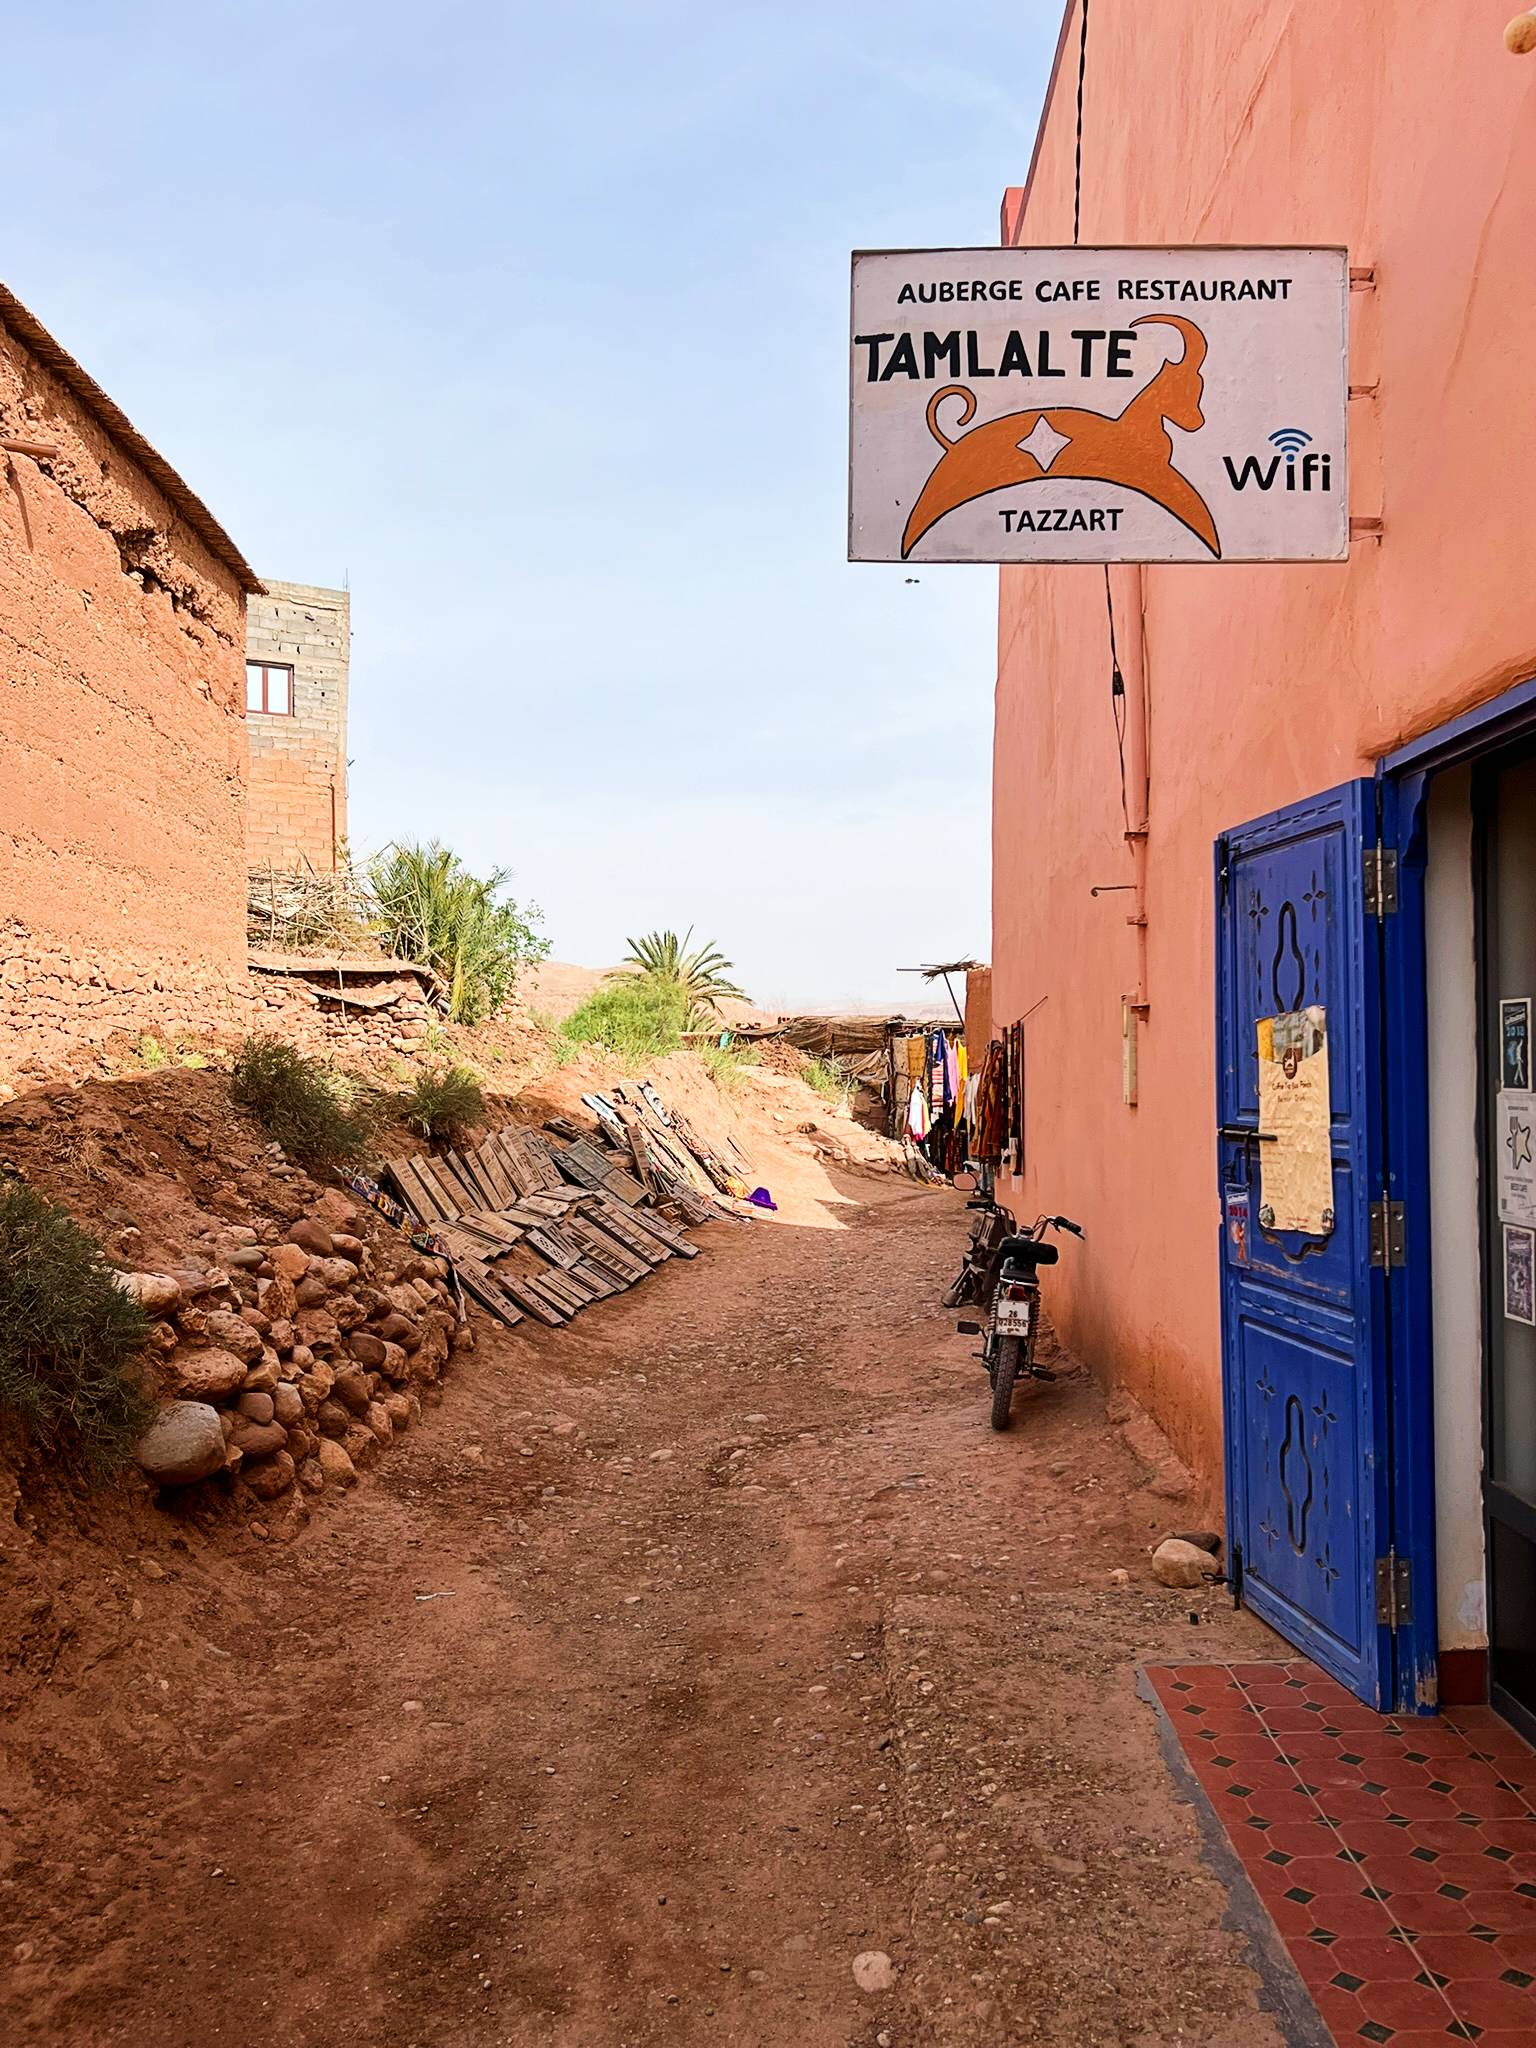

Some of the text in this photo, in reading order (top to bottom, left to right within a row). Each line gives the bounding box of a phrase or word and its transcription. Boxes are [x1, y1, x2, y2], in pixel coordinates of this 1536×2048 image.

[897, 279, 1292, 304] AUBERGE CAFE RESTAURANT
[854, 330, 1137, 382] TAMLALTE
[1223, 454, 1330, 491] Wifi
[999, 509, 1123, 532] TAZZART
